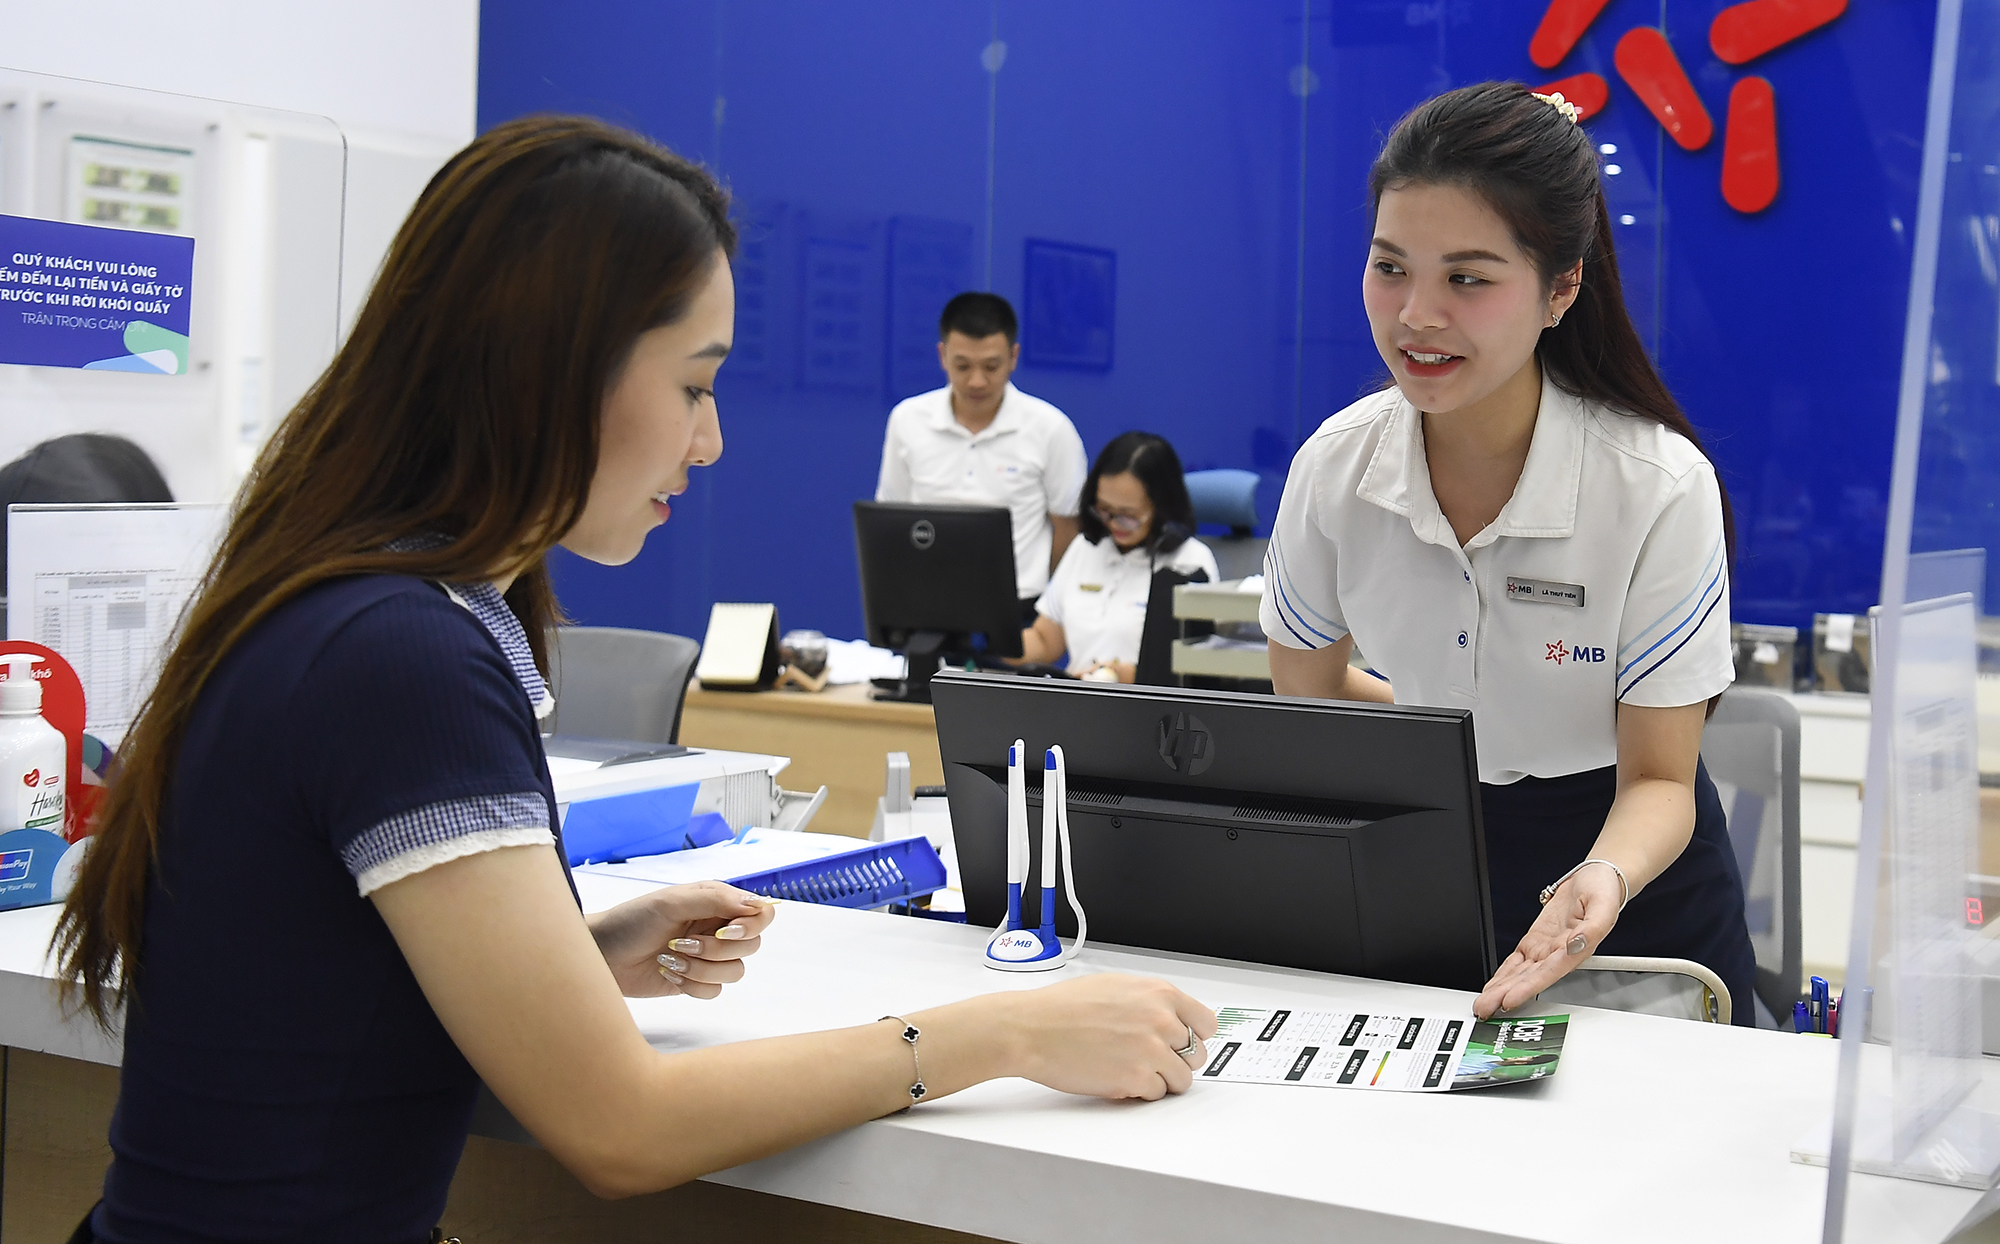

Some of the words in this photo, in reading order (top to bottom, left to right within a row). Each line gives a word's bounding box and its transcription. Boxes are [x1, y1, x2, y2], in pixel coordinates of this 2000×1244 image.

[12, 252, 43, 267] QUÝ
[45, 256, 93, 272] KHÁCH
[95, 261, 118, 275] VUI
[120, 262, 157, 279] LÒNG
[21, 270, 52, 286] ĐẾM
[54, 275, 76, 291] LẠI
[111, 279, 129, 293] VÀ
[131, 281, 162, 296] GIẤY
[164, 284, 184, 298] TỜ
[46, 293, 70, 306] KHI
[72, 294, 96, 308] RỜI
[98, 297, 132, 311] KHỎI
[21, 311, 53, 326] TRÂN
[55, 315, 97, 331] TRỌNG
[98, 316, 125, 331] CẢM
[1518, 585, 1532, 594] MB
[1572, 645, 1606, 662] MB
[1013, 939, 1032, 948] MB
